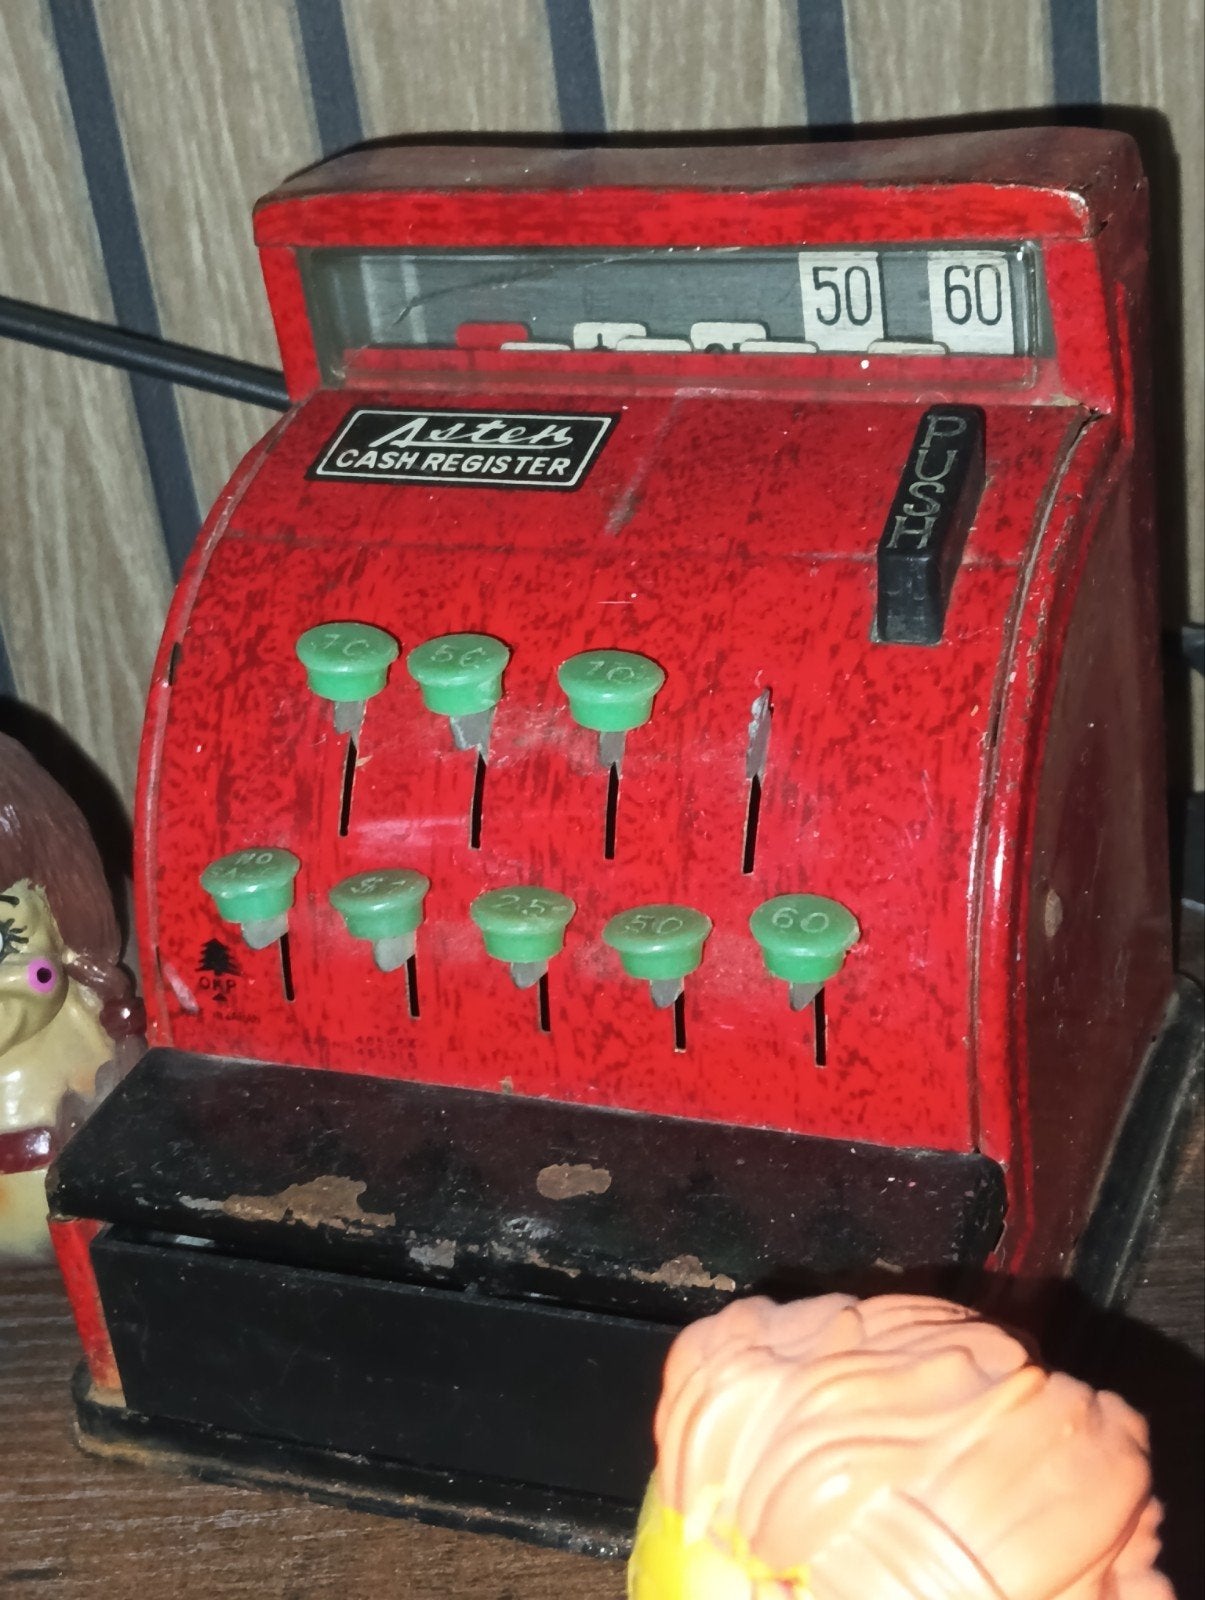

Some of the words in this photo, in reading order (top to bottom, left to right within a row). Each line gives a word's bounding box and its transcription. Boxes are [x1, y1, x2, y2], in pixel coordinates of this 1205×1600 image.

[812, 265, 872, 327] 50
[944, 263, 1002, 326] 60
[335, 448, 416, 471] CASH
[420, 452, 572, 477] REGISTER
[886, 414, 967, 549] PUSH
[770, 906, 831, 934] 60
